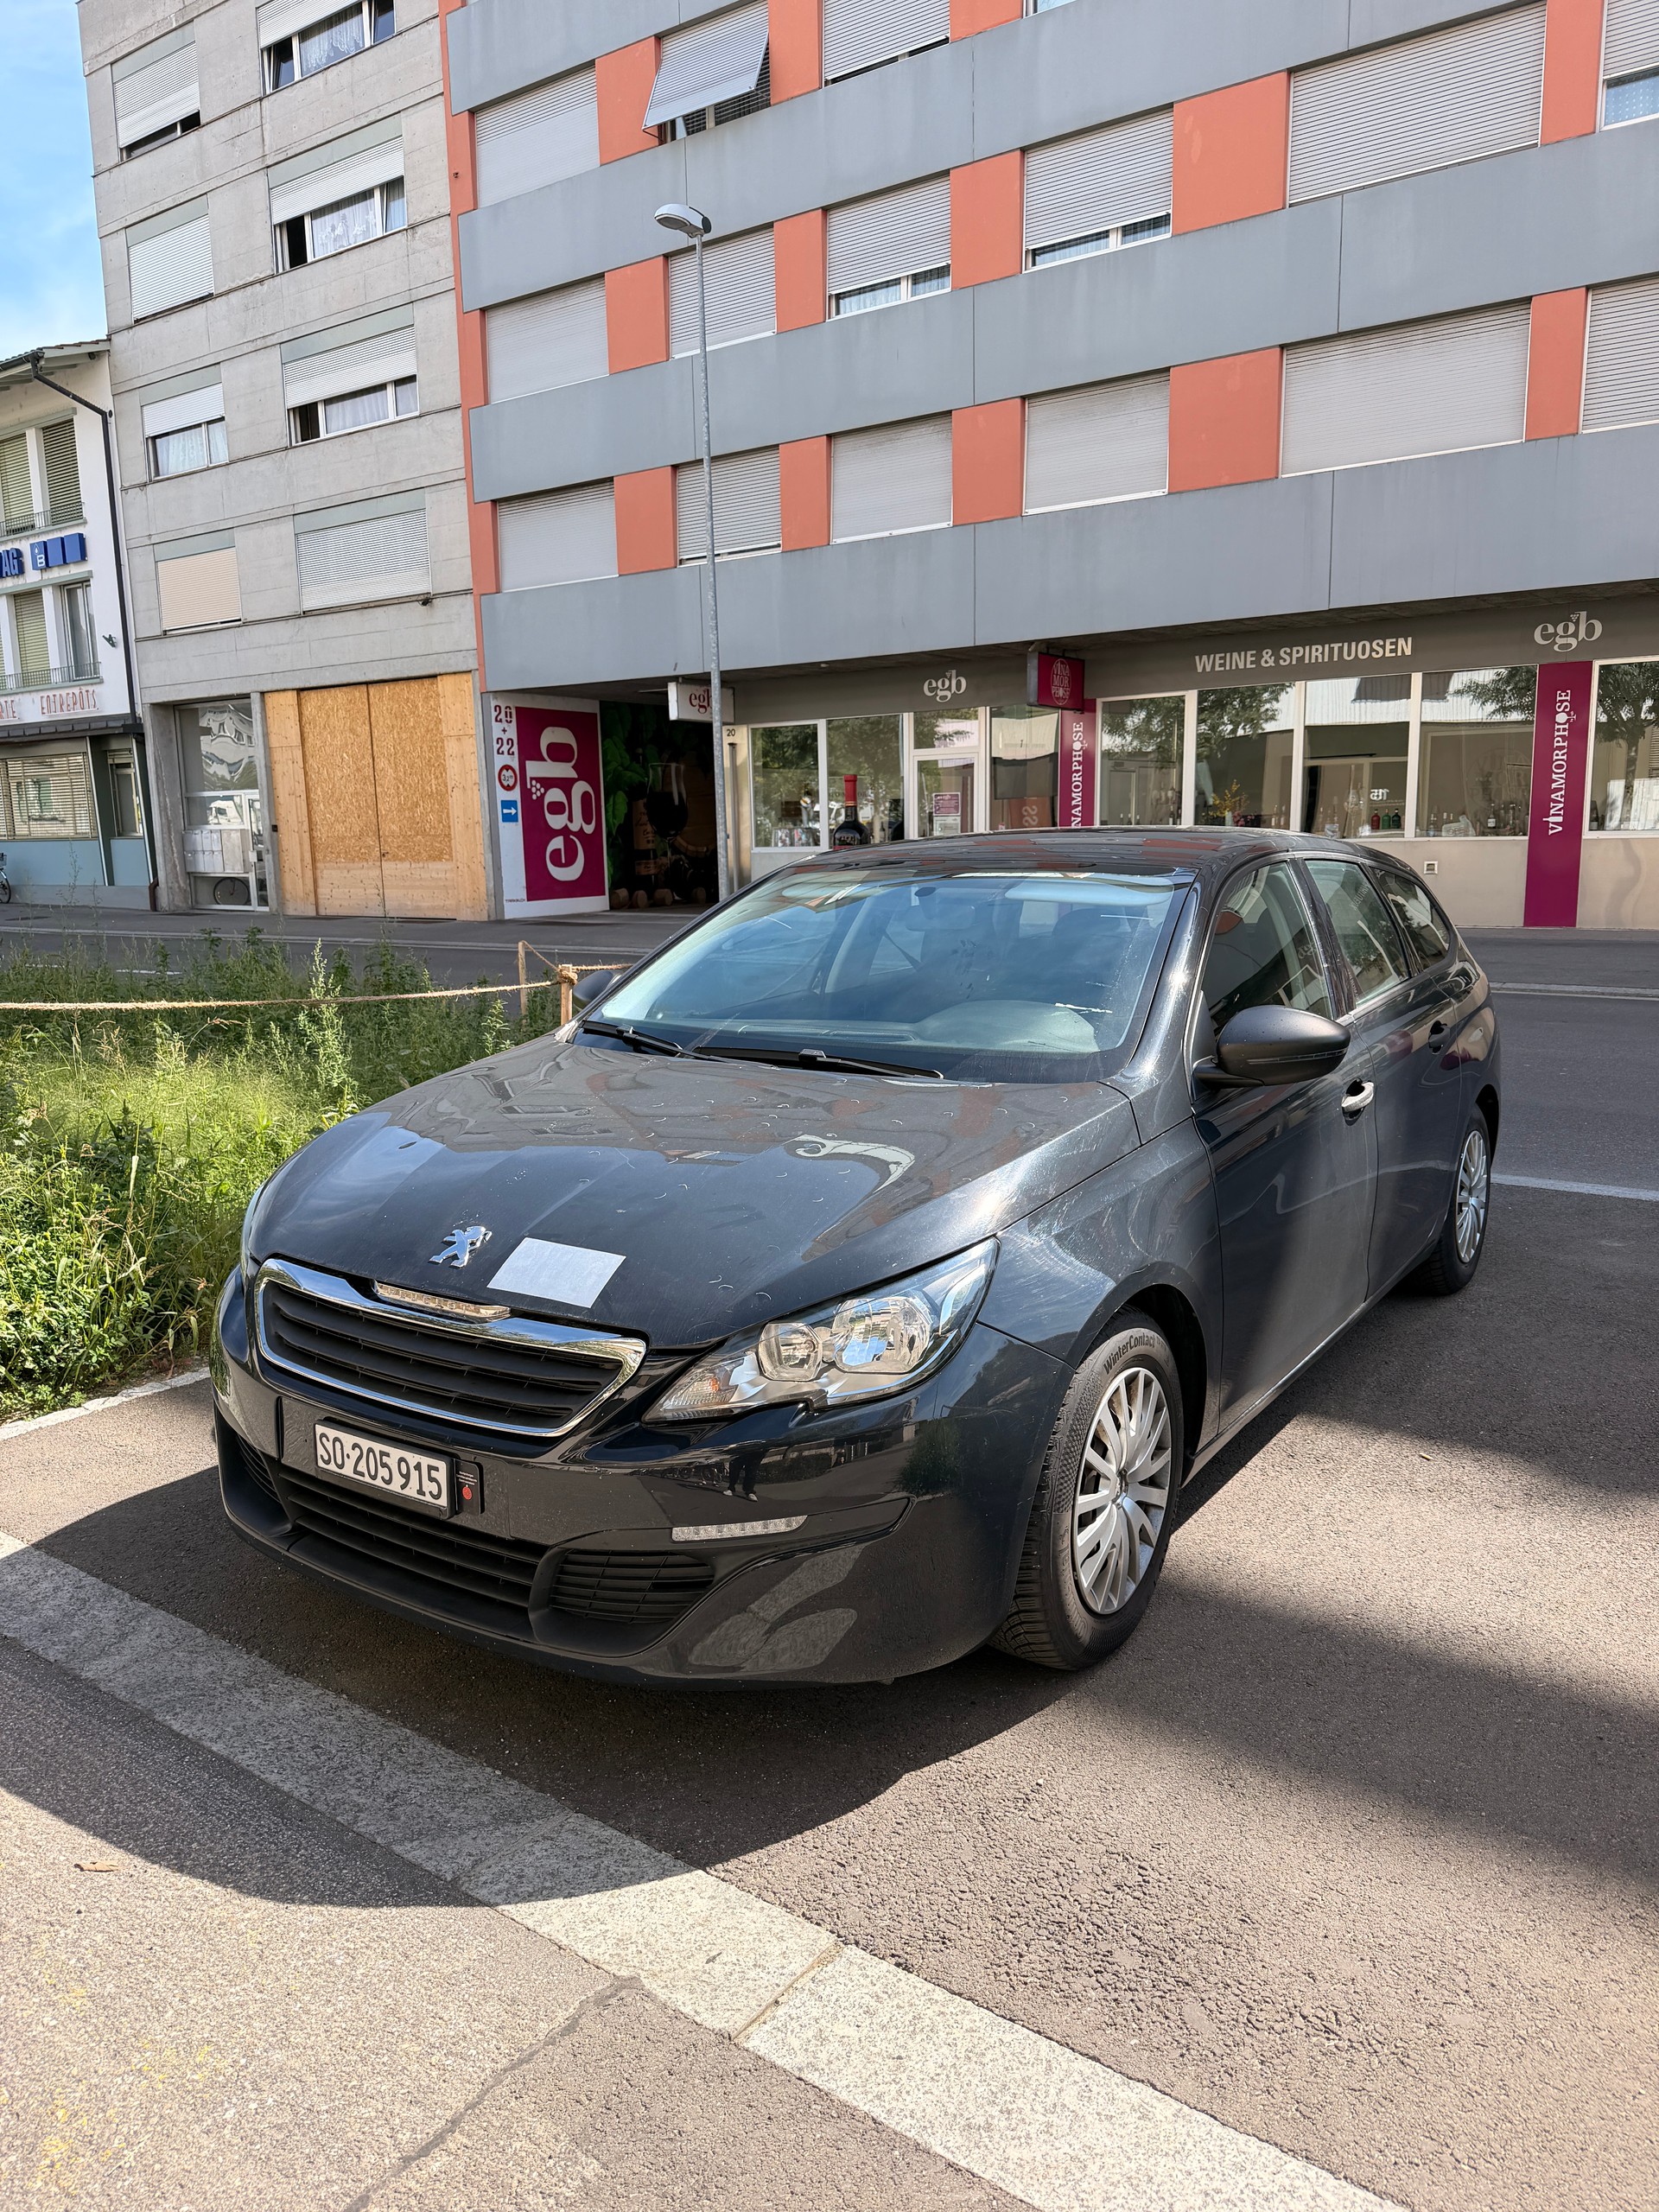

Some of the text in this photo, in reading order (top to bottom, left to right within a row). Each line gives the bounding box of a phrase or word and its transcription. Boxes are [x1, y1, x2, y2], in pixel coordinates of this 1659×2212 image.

[1534, 611, 1603, 652] egb
[1195, 637, 1413, 673] WEINE & SPIRITUOSEN
[923, 670, 967, 702] egb
[1052, 675, 1070, 688] MOR
[41, 687, 97, 715] ENTREPÔTS
[494, 704, 513, 724] 20
[496, 737, 515, 756] 22
[727, 728, 736, 737] 20
[525, 727, 596, 881] egb
[1103, 1332, 1156, 1376] WinterContact
